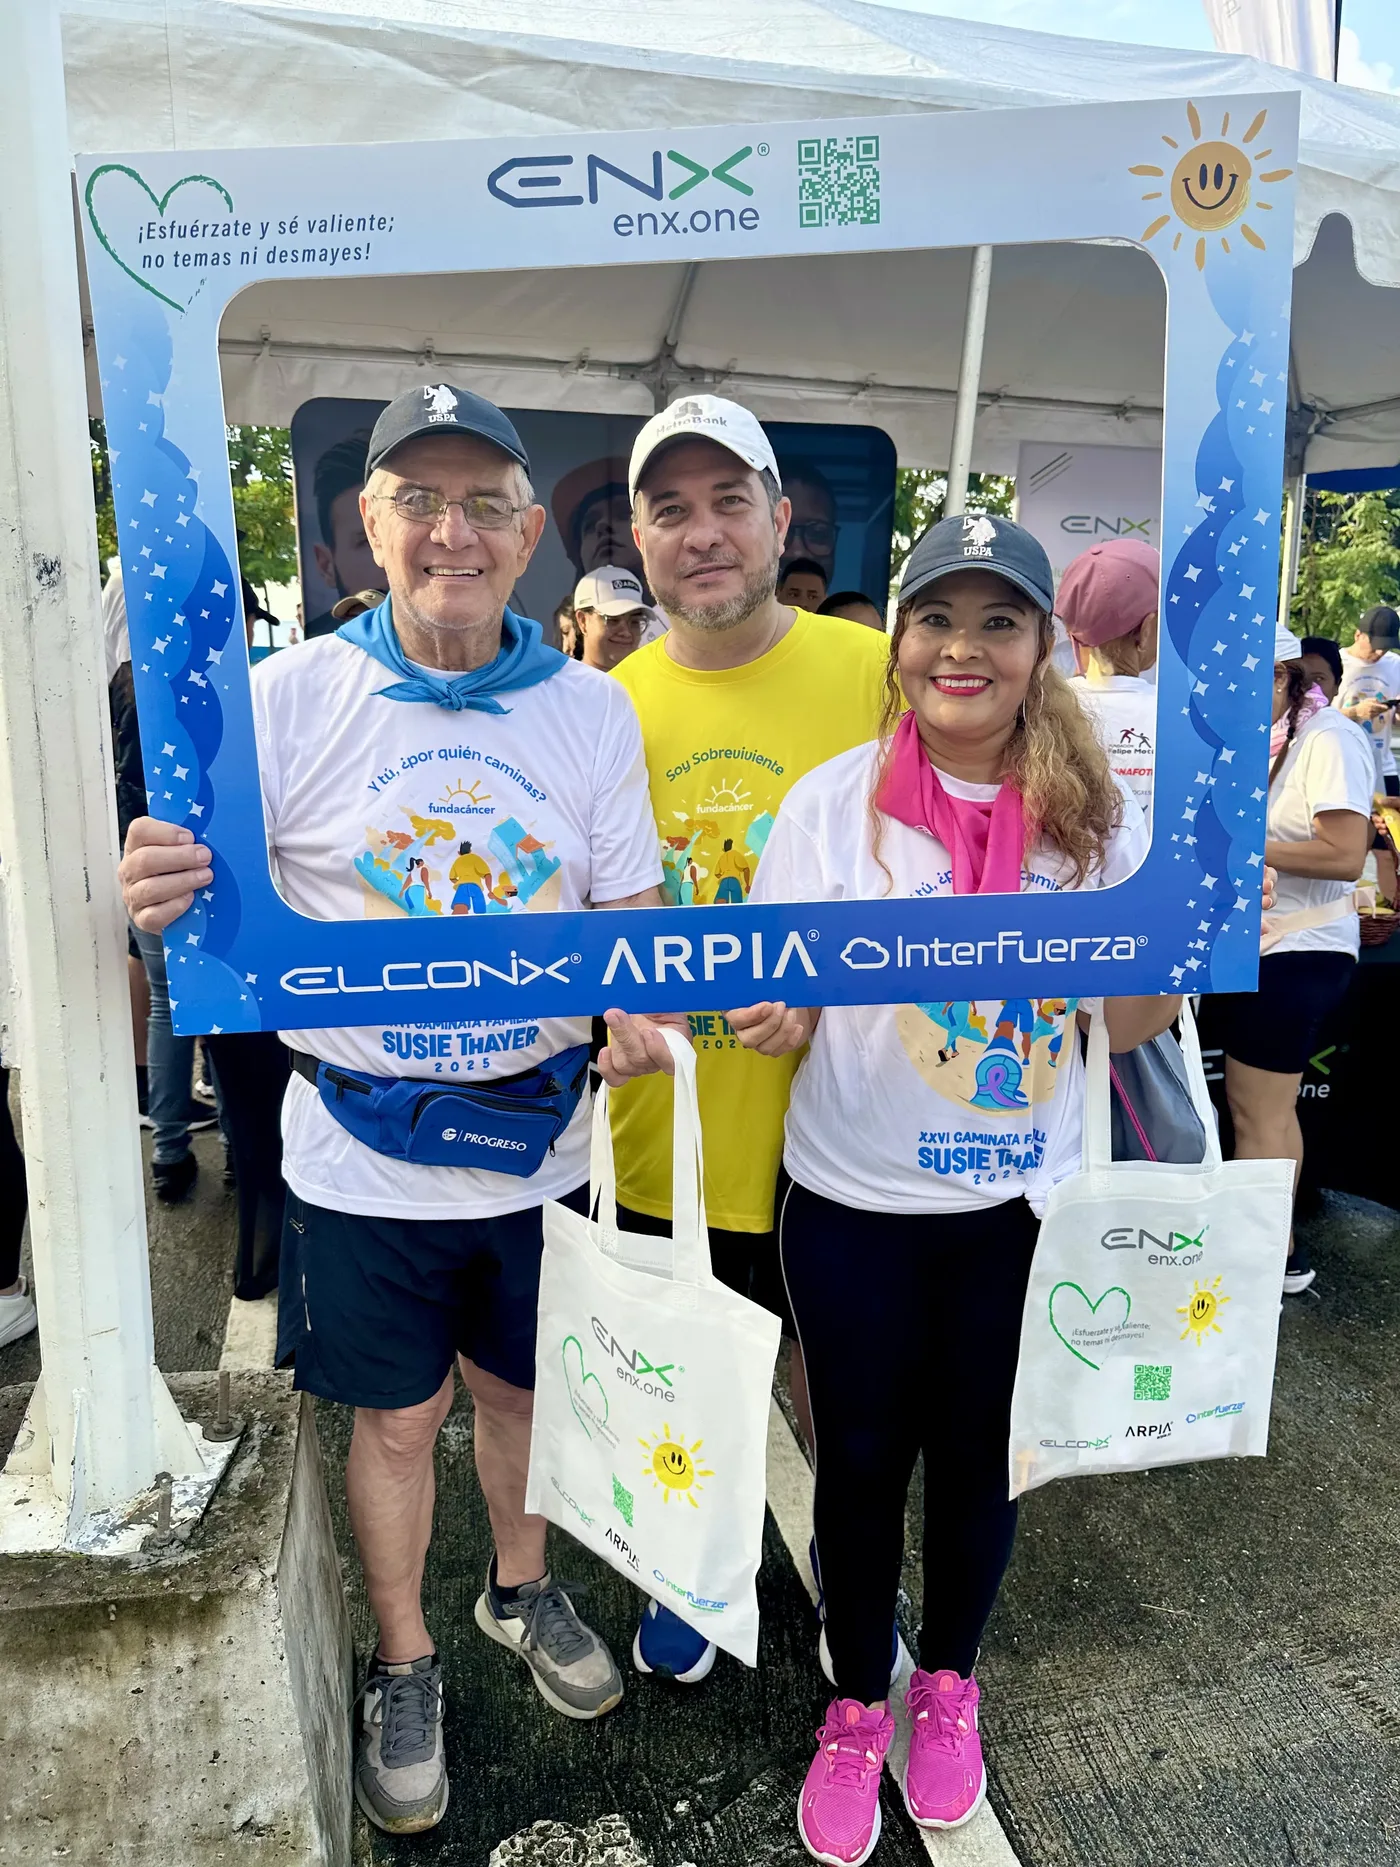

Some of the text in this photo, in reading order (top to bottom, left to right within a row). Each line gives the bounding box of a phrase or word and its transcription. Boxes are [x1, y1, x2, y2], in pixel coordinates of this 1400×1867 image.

[138, 214, 394, 243] ¡Esfuérzate y sé valiente;
[613, 207, 760, 236] enx.one
[142, 242, 371, 268] no temas ni desmayes!
[428, 413, 458, 423] USPA
[1060, 515, 1151, 535] ENX
[963, 546, 993, 557] USPA
[367, 745, 547, 802] Y tú, ¿por quién caminas?
[666, 746, 784, 782] Soy Sobreviviente
[428, 803, 496, 814] fundacáncer
[696, 803, 754, 814] fundacáncer
[601, 930, 819, 986] ARPIA
[897, 931, 1136, 968] InterFuerza
[382, 1026, 540, 1060] SUSIE THAYER
[434, 1057, 490, 1073] 2025
[463, 1132, 527, 1151] PROGRESO
[918, 1131, 950, 1144] XXVI
[953, 1131, 1020, 1146] CAMINATA
[918, 1146, 991, 1175] SUSIE
[1100, 1227, 1205, 1252] ENX
[1148, 1251, 1203, 1266] enx.one
[616, 1366, 675, 1403] enx.one
[1125, 1422, 1171, 1437] ARPIA
